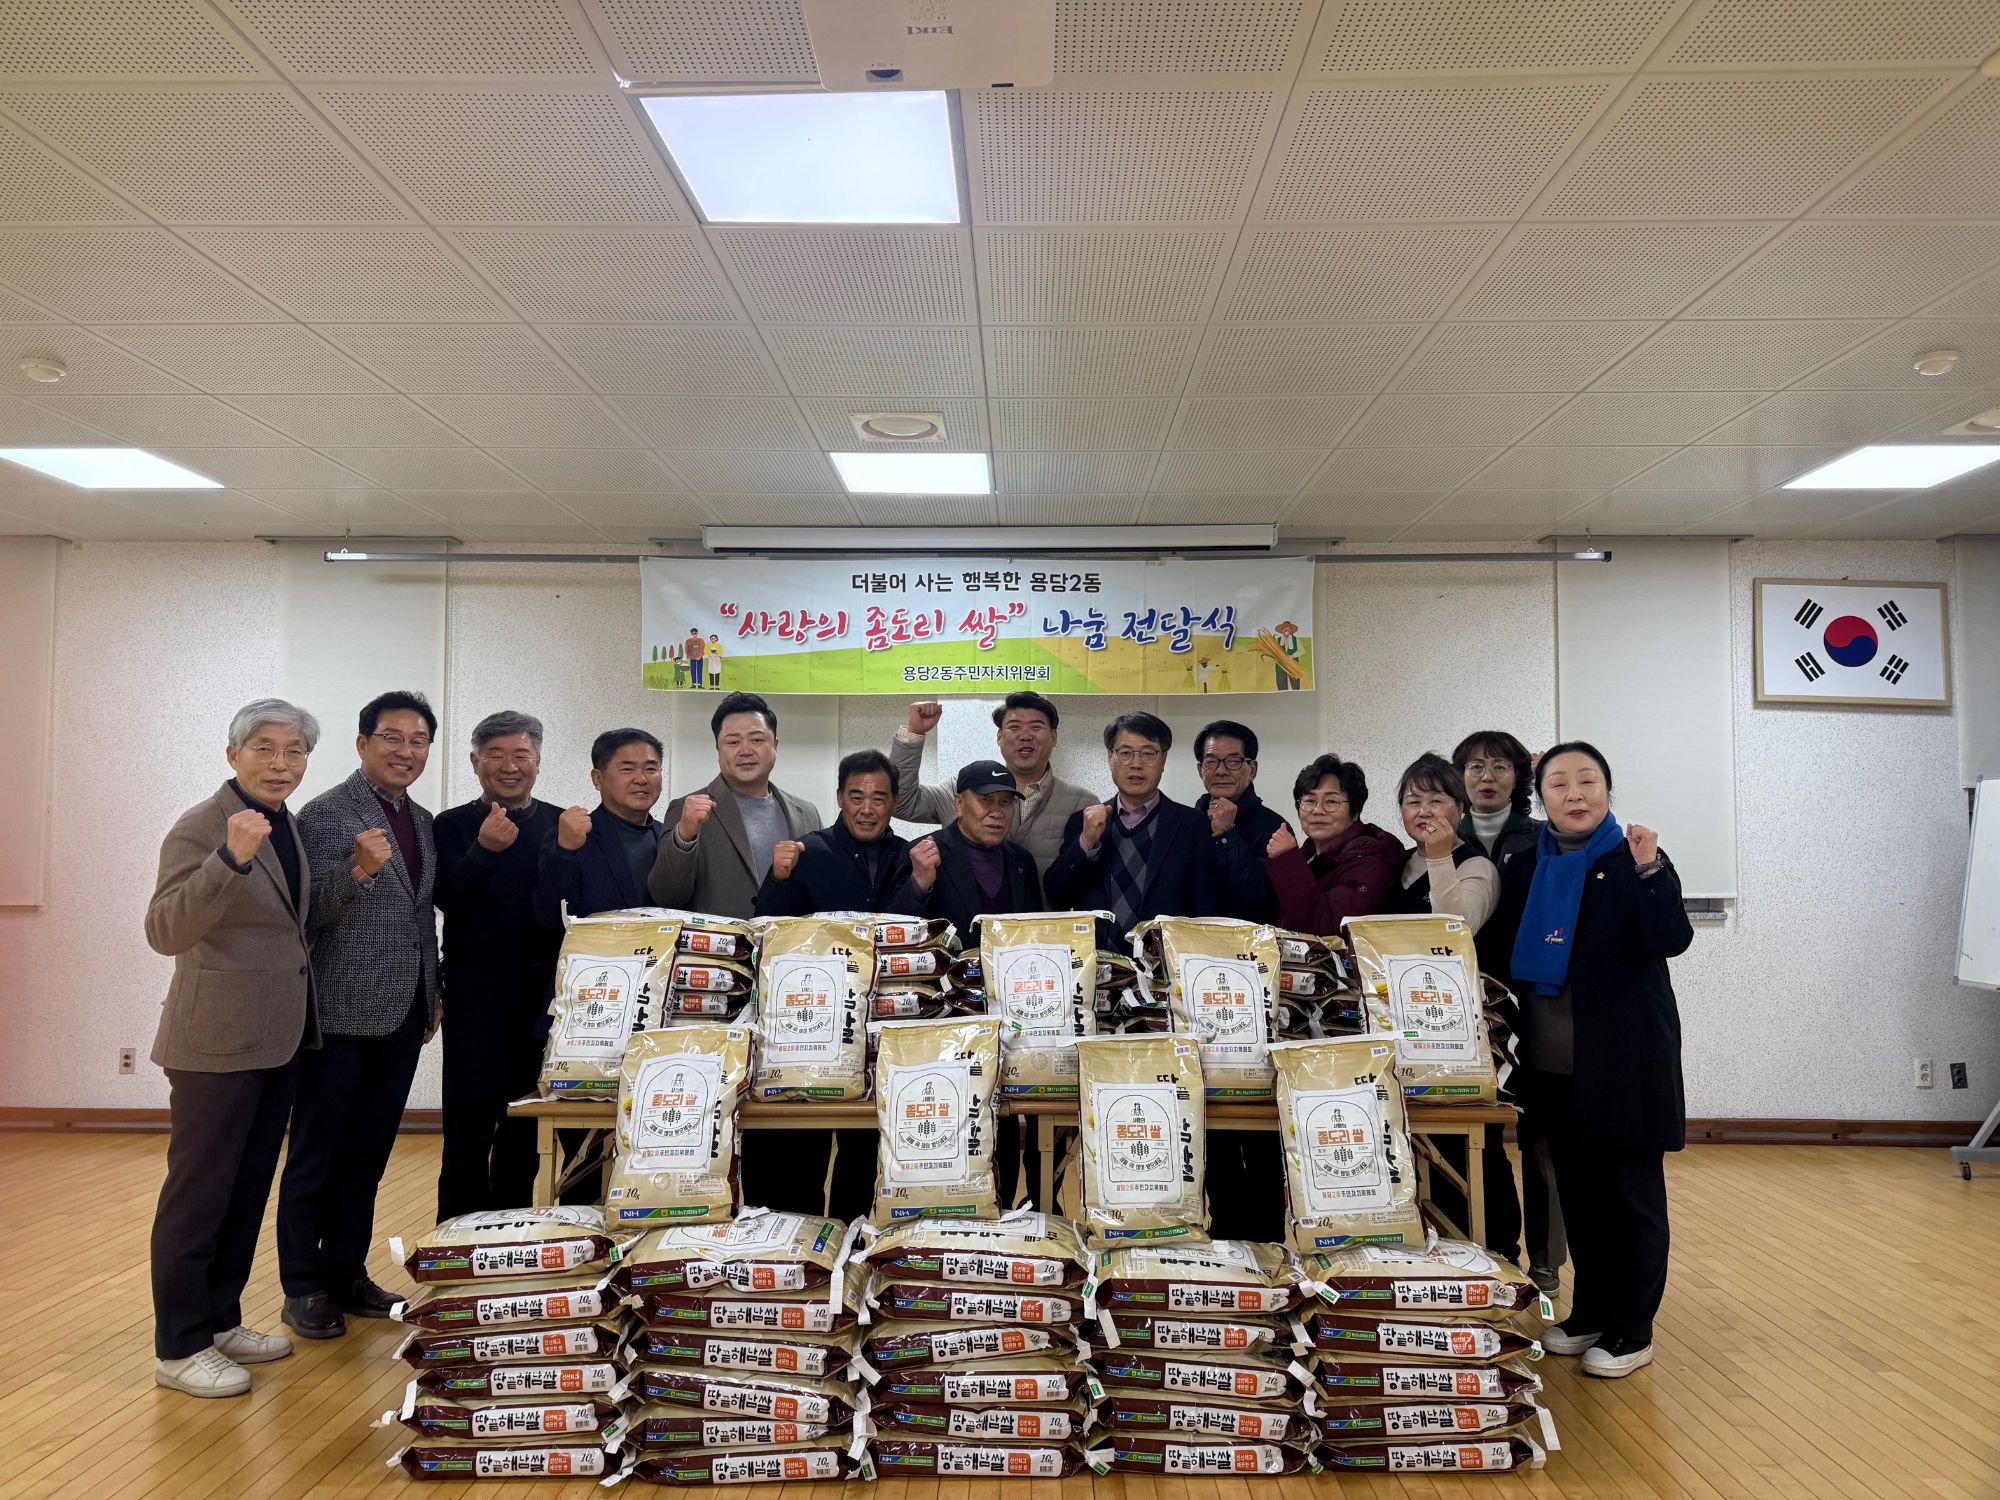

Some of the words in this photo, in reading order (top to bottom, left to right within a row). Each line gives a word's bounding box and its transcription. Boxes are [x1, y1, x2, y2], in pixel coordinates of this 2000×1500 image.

[852, 573, 906, 593] 더불어
[915, 574, 954, 592] 사는
[962, 572, 1021, 591] 행복한
[865, 606, 944, 650] 좀도리
[1043, 608, 1106, 649] 나눔
[1120, 606, 1235, 652] 전달식
[903, 664, 1051, 682] 용당2동주민자치위원회
[475, 1248, 538, 1271] 땅끝해남쌀
[945, 1258, 1009, 1280] 땅끝해남쌀
[690, 1264, 750, 1287] 땅끝해남쌀
[1171, 1288, 1235, 1308] 땅끝해남쌀
[1397, 1285, 1463, 1304] 땅끝해남쌀
[480, 1301, 544, 1321] 땅끝해남쌀
[713, 1306, 779, 1326] 땅끝해남쌀
[954, 1297, 1018, 1319] 땅끝해남쌀
[934, 1334, 999, 1357] 땅끝해남쌀
[1157, 1324, 1222, 1346] 땅끝해남쌀
[1382, 1328, 1449, 1351] 땅끝해남쌀
[476, 1335, 540, 1357] 땅끝해남쌀
[708, 1344, 773, 1366] 땅끝해남쌀
[493, 1370, 558, 1390] 땅끝해남쌀
[948, 1379, 1012, 1399] 땅끝해남쌀
[1168, 1366, 1233, 1391] 땅끝해남쌀
[1387, 1372, 1453, 1392] 땅끝해남쌀
[708, 1389, 771, 1415] 땅끝해남쌀
[475, 1411, 540, 1432] 땅끝해남쌀
[953, 1414, 1015, 1434] 땅끝해남쌀
[1173, 1409, 1236, 1432] 땅끝해남쌀
[1388, 1409, 1455, 1430] 땅끝해남쌀
[706, 1426, 771, 1443] 땅끝해남쌀
[479, 1452, 545, 1473] 땅끝해남쌀
[715, 1459, 781, 1480] 땅끝해남쌀
[940, 1452, 1005, 1471] 땅끝해남쌀
[1168, 1449, 1232, 1470] 땅끝해남쌀
[1392, 1451, 1457, 1469] 땅끝해남쌀
